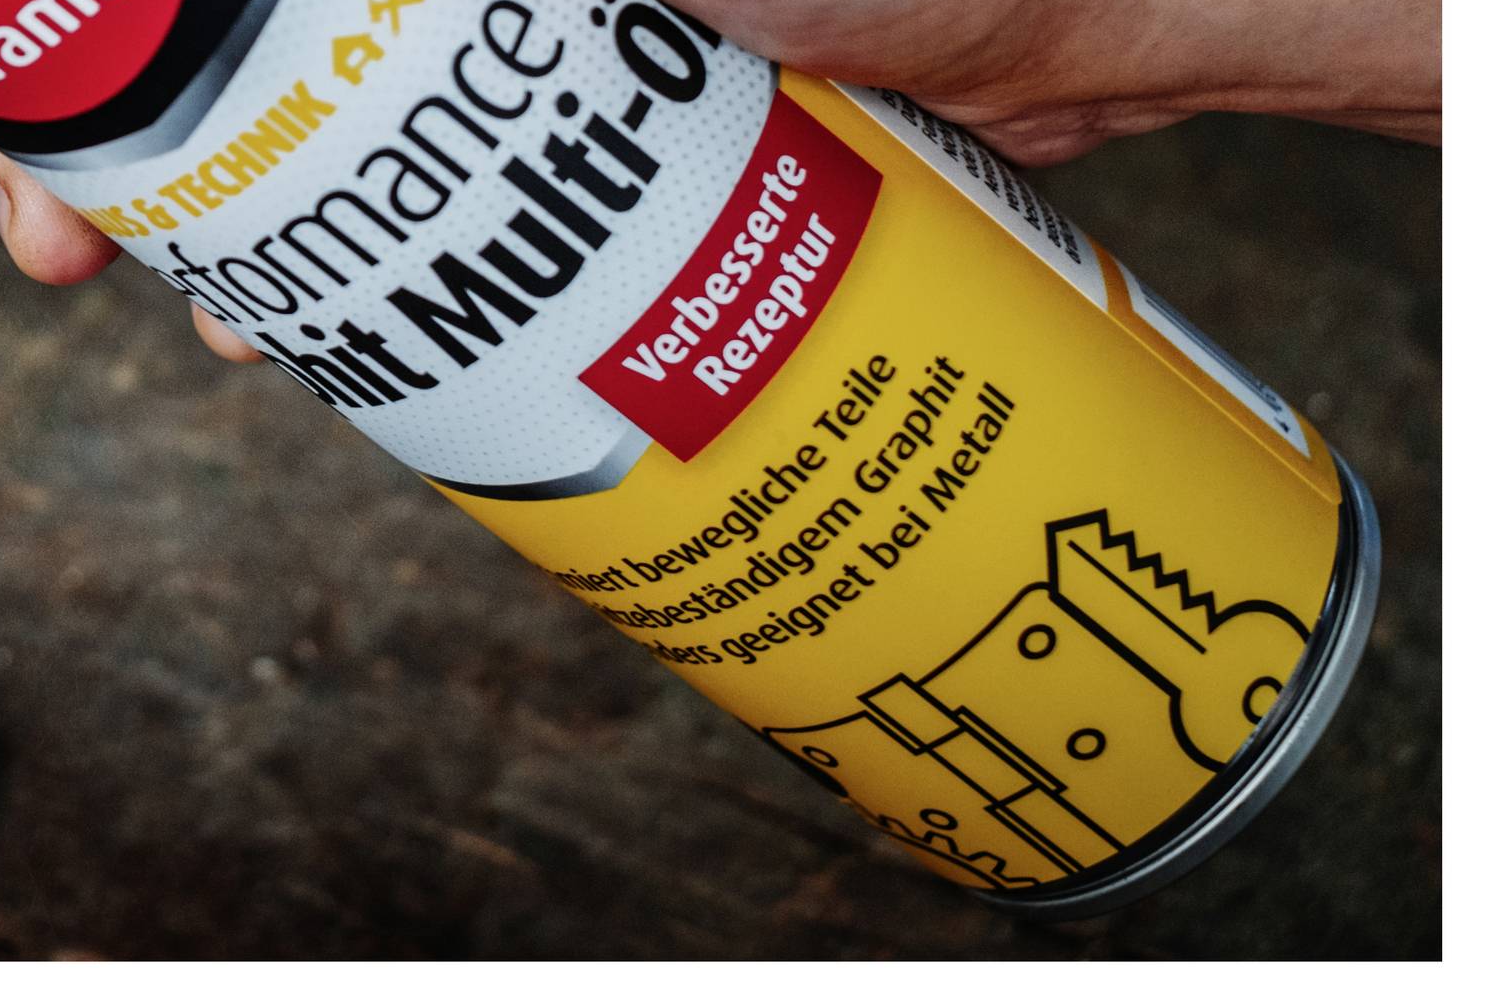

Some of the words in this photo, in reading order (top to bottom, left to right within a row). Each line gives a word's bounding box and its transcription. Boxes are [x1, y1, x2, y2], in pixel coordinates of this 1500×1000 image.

[77, 205, 150, 238] AUS
[131, 198, 180, 231] &
[157, 80, 337, 217] TECHNIK
[150, 0, 565, 324] erformance
[621, 154, 807, 383] Verbesserte
[254, 318, 441, 423] phit
[692, 211, 837, 397] Rezeptur
[552, 567, 641, 592] miert
[621, 442, 828, 583] bewegliche
[812, 353, 897, 445] Teile
[592, 496, 863, 629] tzebeständigem
[854, 354, 966, 496] Graphit
[721, 563, 876, 665] geeignet
[860, 505, 931, 572] bei
[919, 381, 1016, 513] Metall
